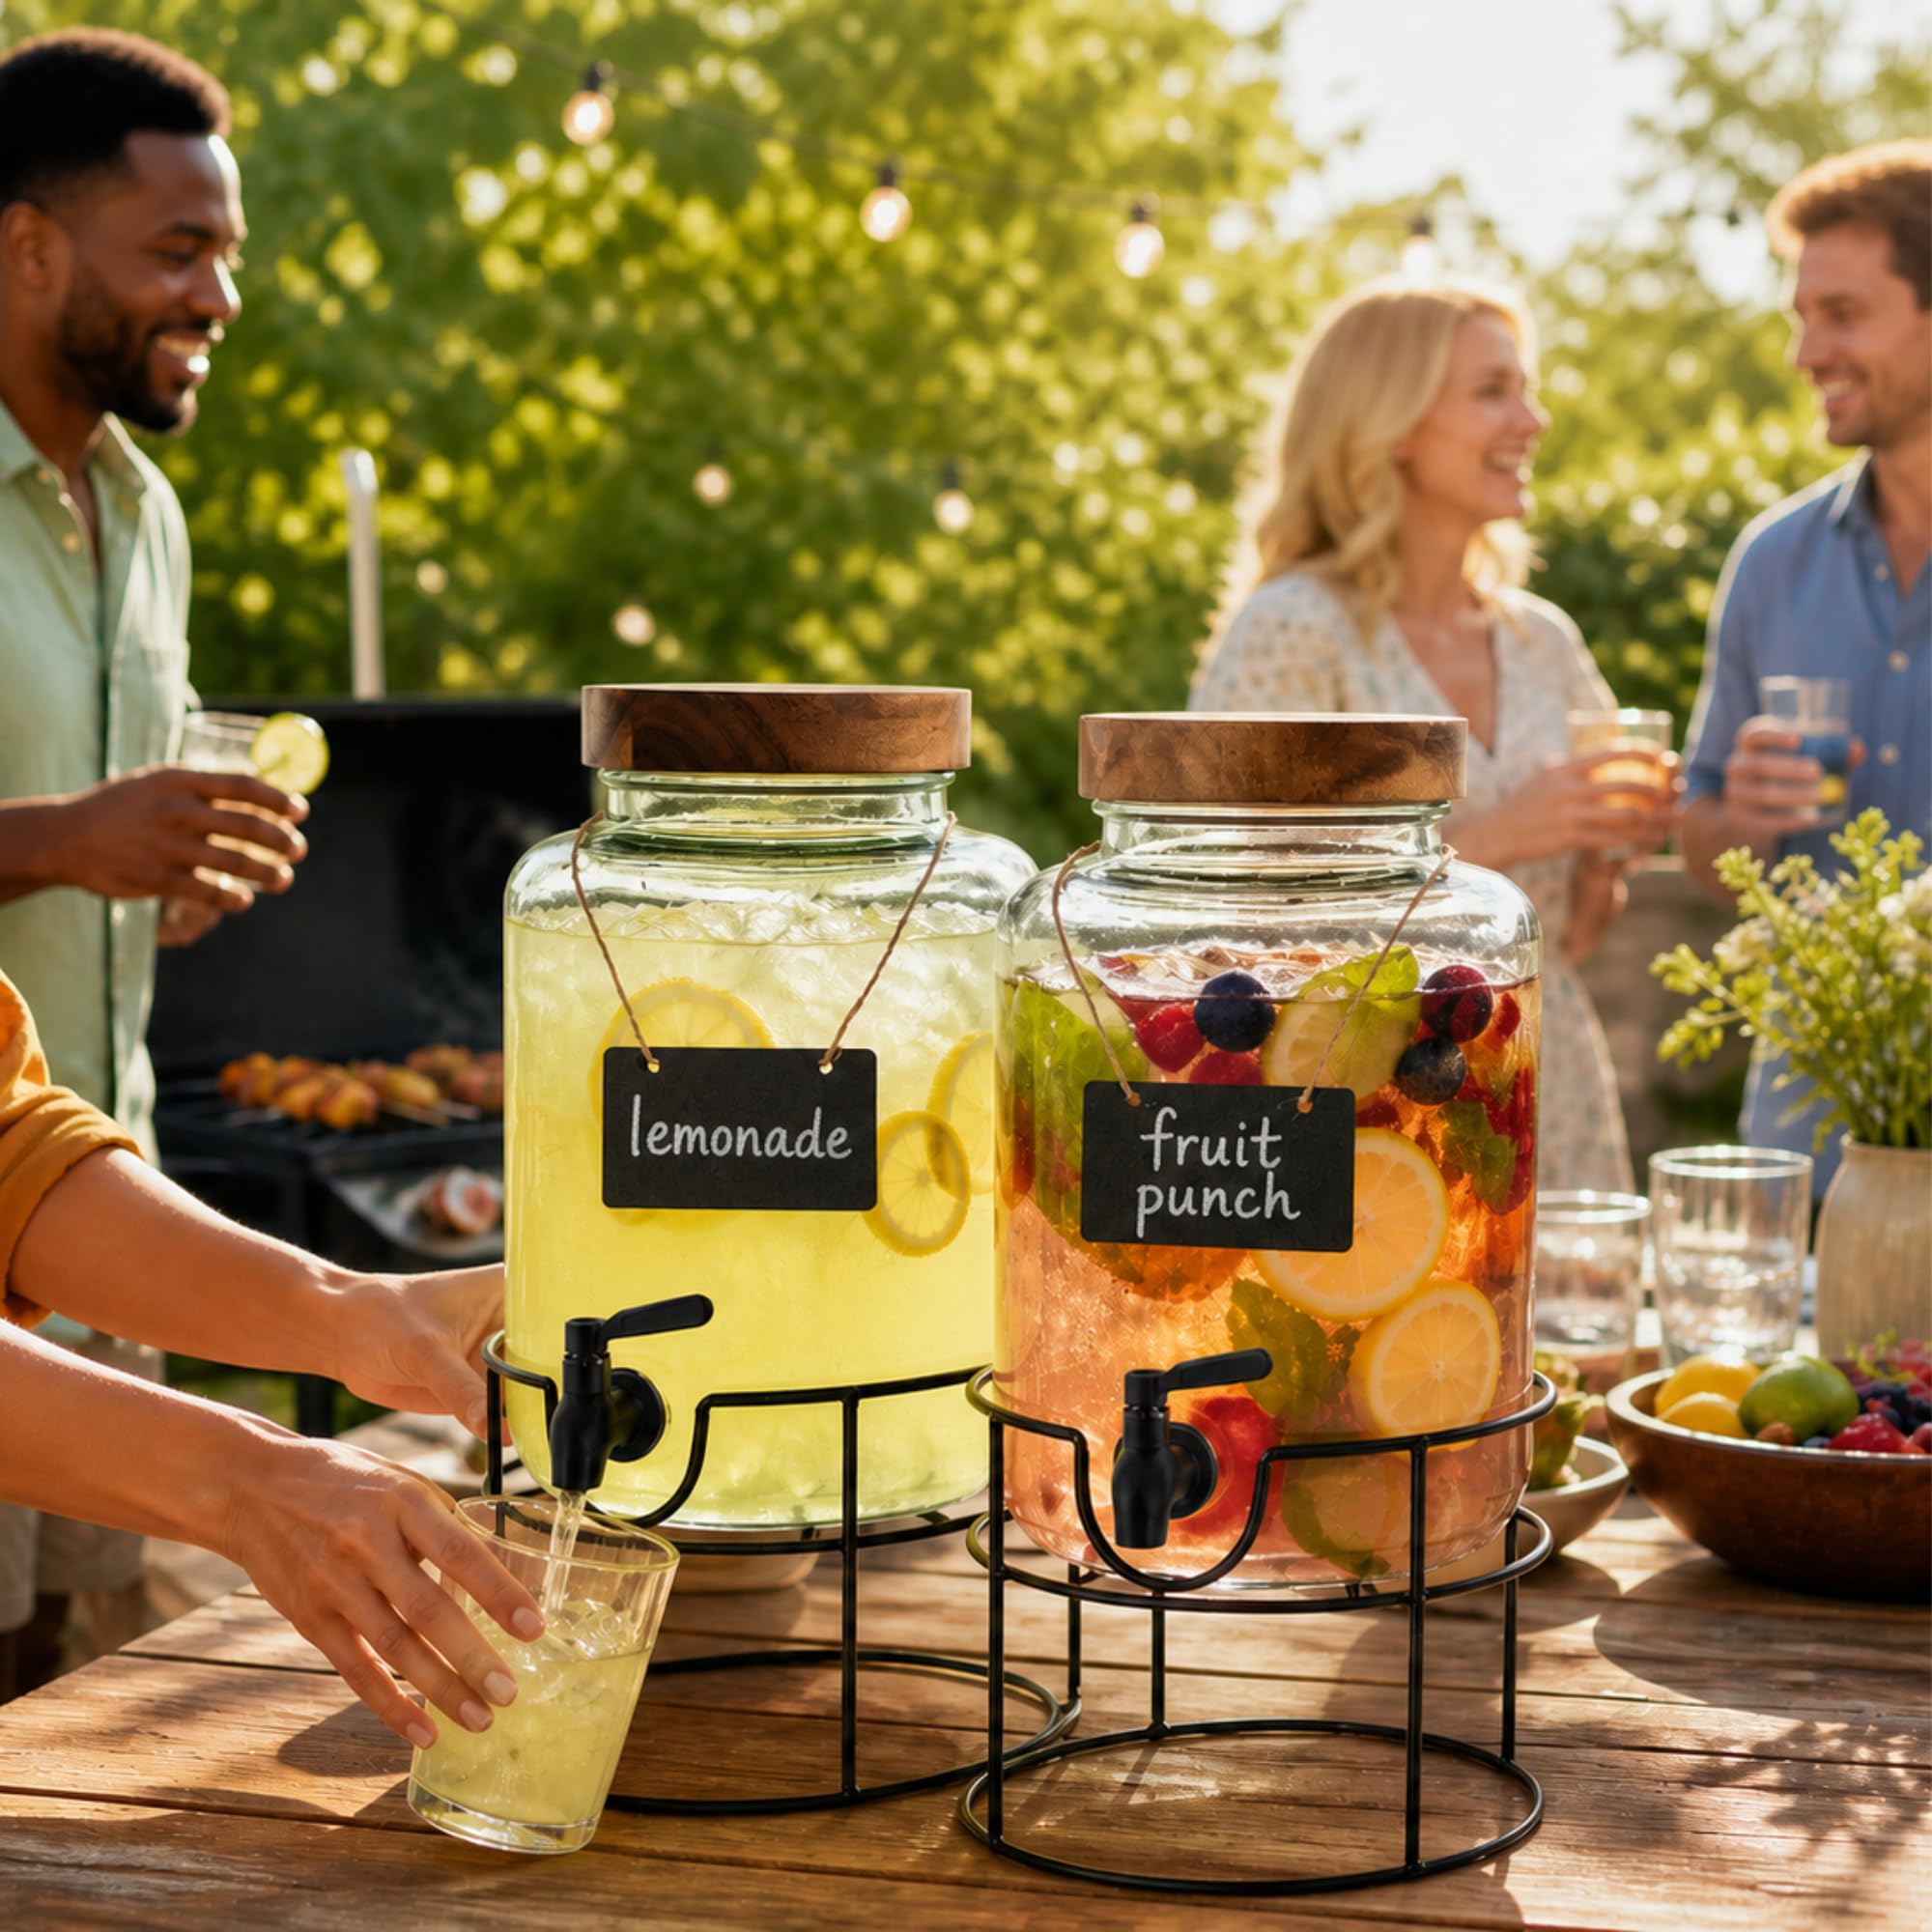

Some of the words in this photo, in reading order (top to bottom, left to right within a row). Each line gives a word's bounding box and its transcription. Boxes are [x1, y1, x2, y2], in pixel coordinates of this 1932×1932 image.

[631, 1094, 852, 1159] lemonade
[1140, 1106, 1282, 1172] fruit
[1136, 1171, 1301, 1238] punch
